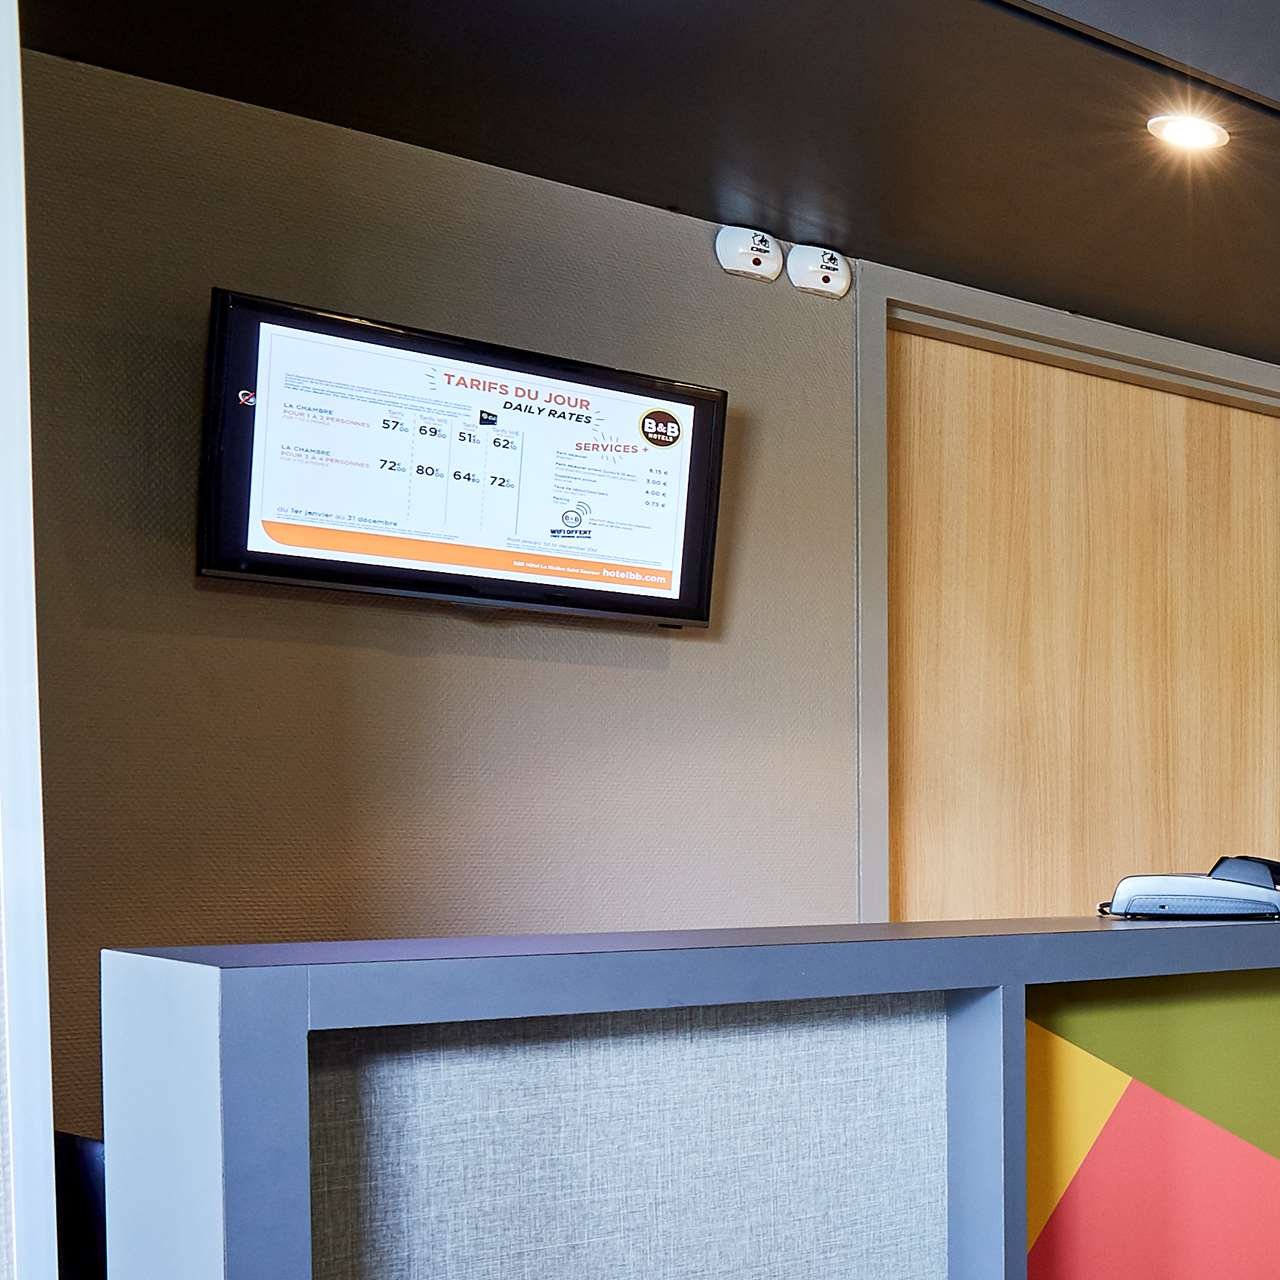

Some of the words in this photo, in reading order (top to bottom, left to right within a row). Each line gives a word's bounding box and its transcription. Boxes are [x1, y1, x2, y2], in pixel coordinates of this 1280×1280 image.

[443, 373, 509, 395] TARIFS
[514, 386, 539, 401] DU
[543, 392, 591, 411] JOUR
[502, 401, 546, 416] DAILY
[547, 409, 592, 424] RATES
[643, 418, 680, 437] B&B
[648, 432, 673, 442] HOTELS
[575, 442, 638, 453] SERVICES
[602, 567, 666, 584] hotelbb.com
